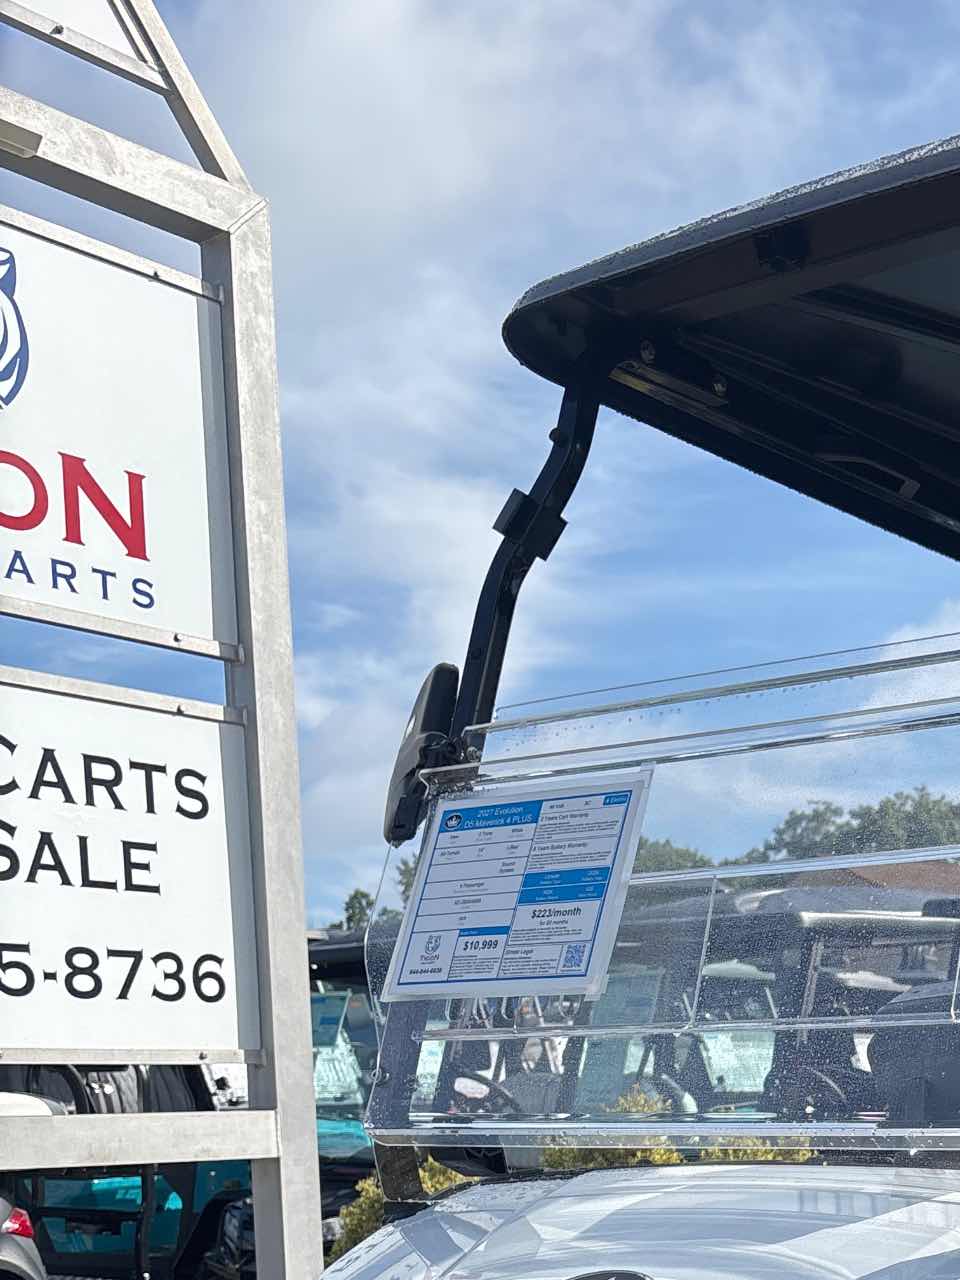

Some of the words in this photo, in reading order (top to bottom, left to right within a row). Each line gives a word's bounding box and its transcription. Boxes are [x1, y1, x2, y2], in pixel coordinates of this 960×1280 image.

[494, 806, 524, 816] Evolution
[511, 814, 534, 823] PLUS
[0, 818, 162, 896] SALE
[530, 906, 582, 919] $223/month
[463, 939, 499, 952] $10,999
[0, 942, 227, 1004] 5-8736
